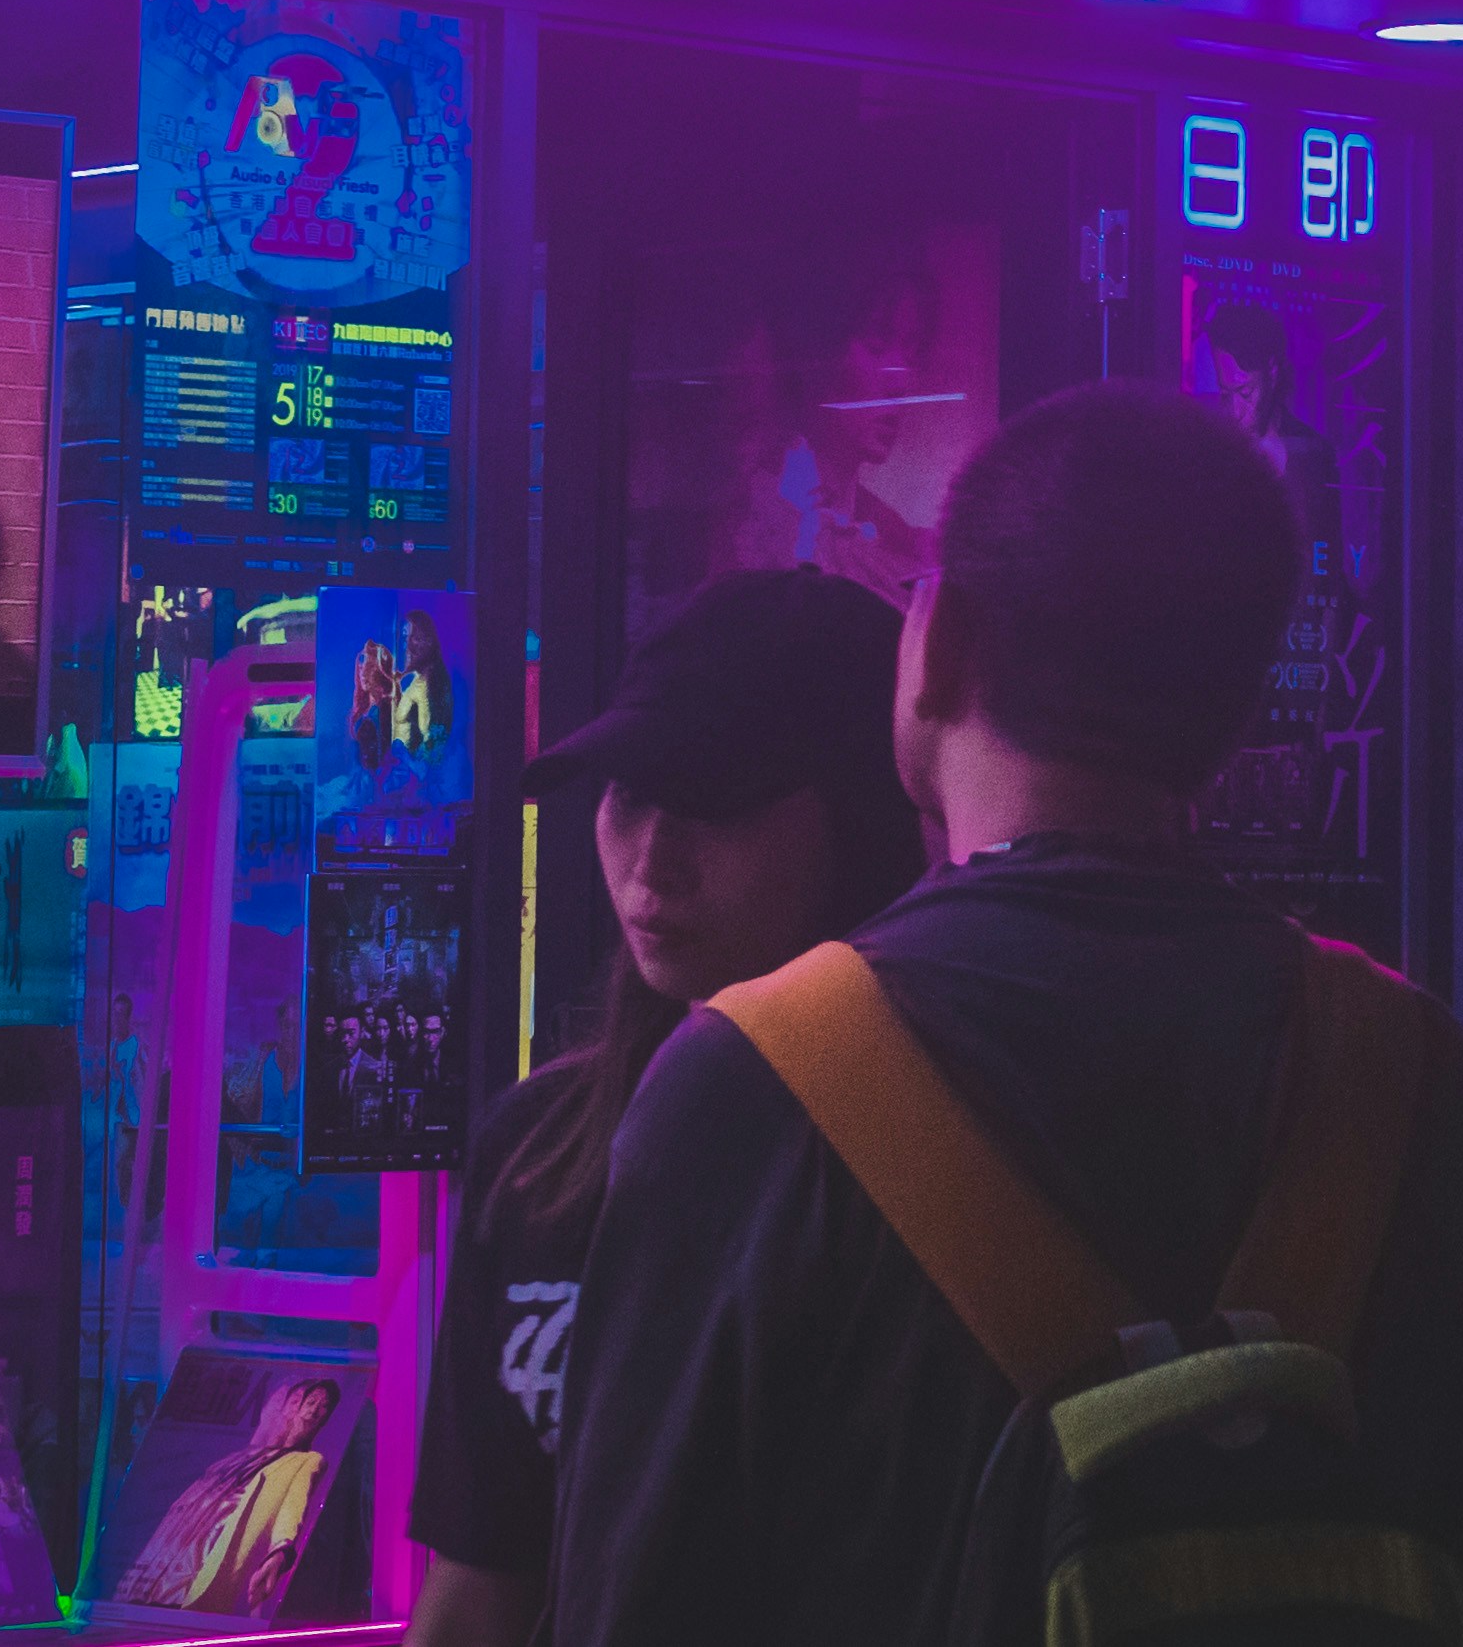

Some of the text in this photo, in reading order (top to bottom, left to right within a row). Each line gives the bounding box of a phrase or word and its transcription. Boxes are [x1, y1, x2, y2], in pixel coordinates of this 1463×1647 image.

[229, 165, 272, 185] Audio
[273, 315, 328, 343] KITEC
[272, 362, 298, 377] 2019
[306, 364, 324, 385] 17
[271, 382, 296, 426] 5
[306, 386, 323, 407] 18
[305, 408, 323, 428] 19
[268, 493, 298, 515] $30
[368, 499, 398, 520] $60
